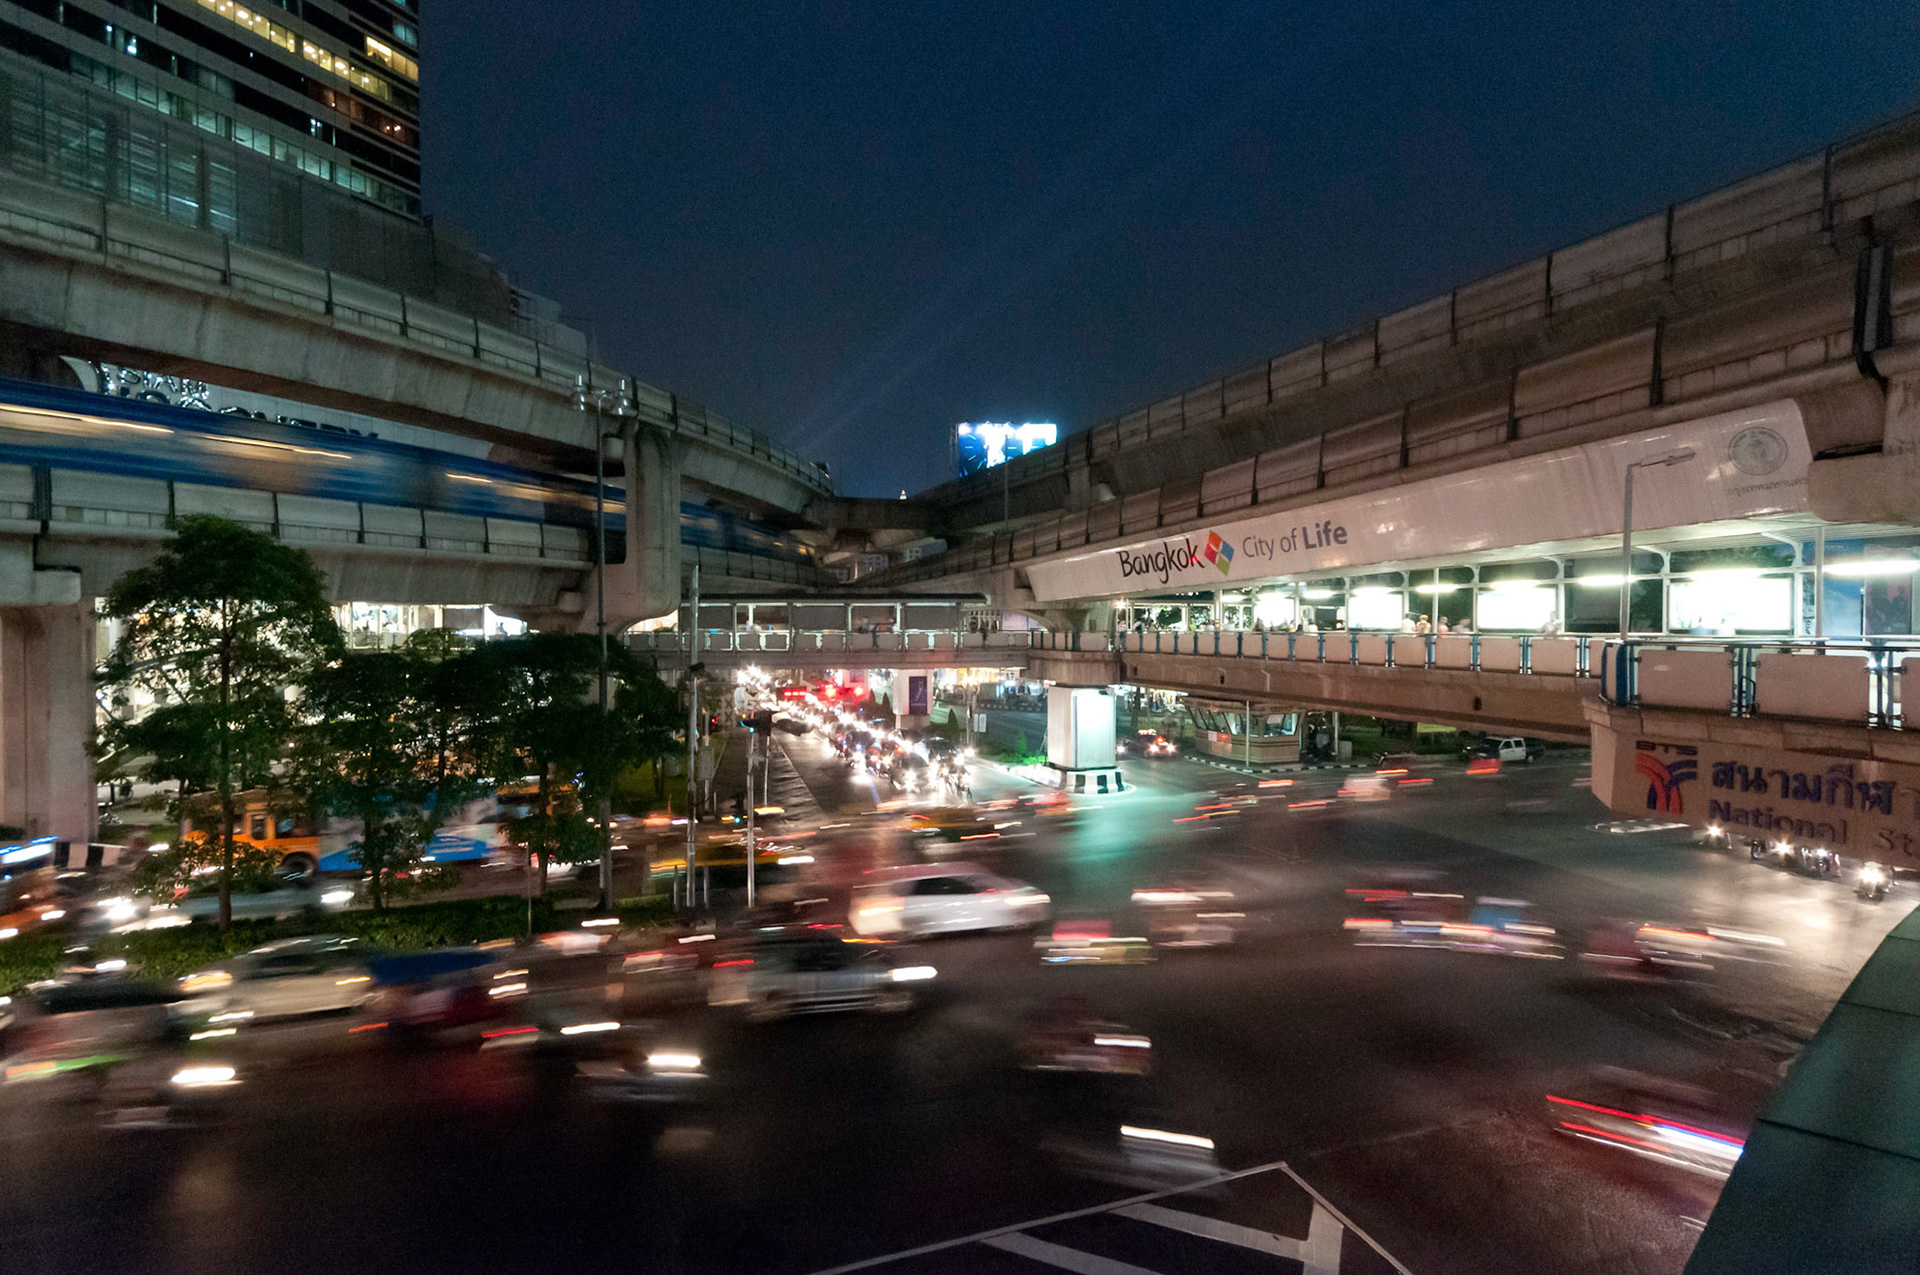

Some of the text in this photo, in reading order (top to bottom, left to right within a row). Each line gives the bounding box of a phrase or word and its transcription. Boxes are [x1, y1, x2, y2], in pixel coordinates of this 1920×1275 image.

[1116, 537, 1205, 584] Bangkok
[1242, 520, 1347, 561] City of Life
[1636, 740, 1698, 756] BTS
[1709, 799, 1848, 844] National
